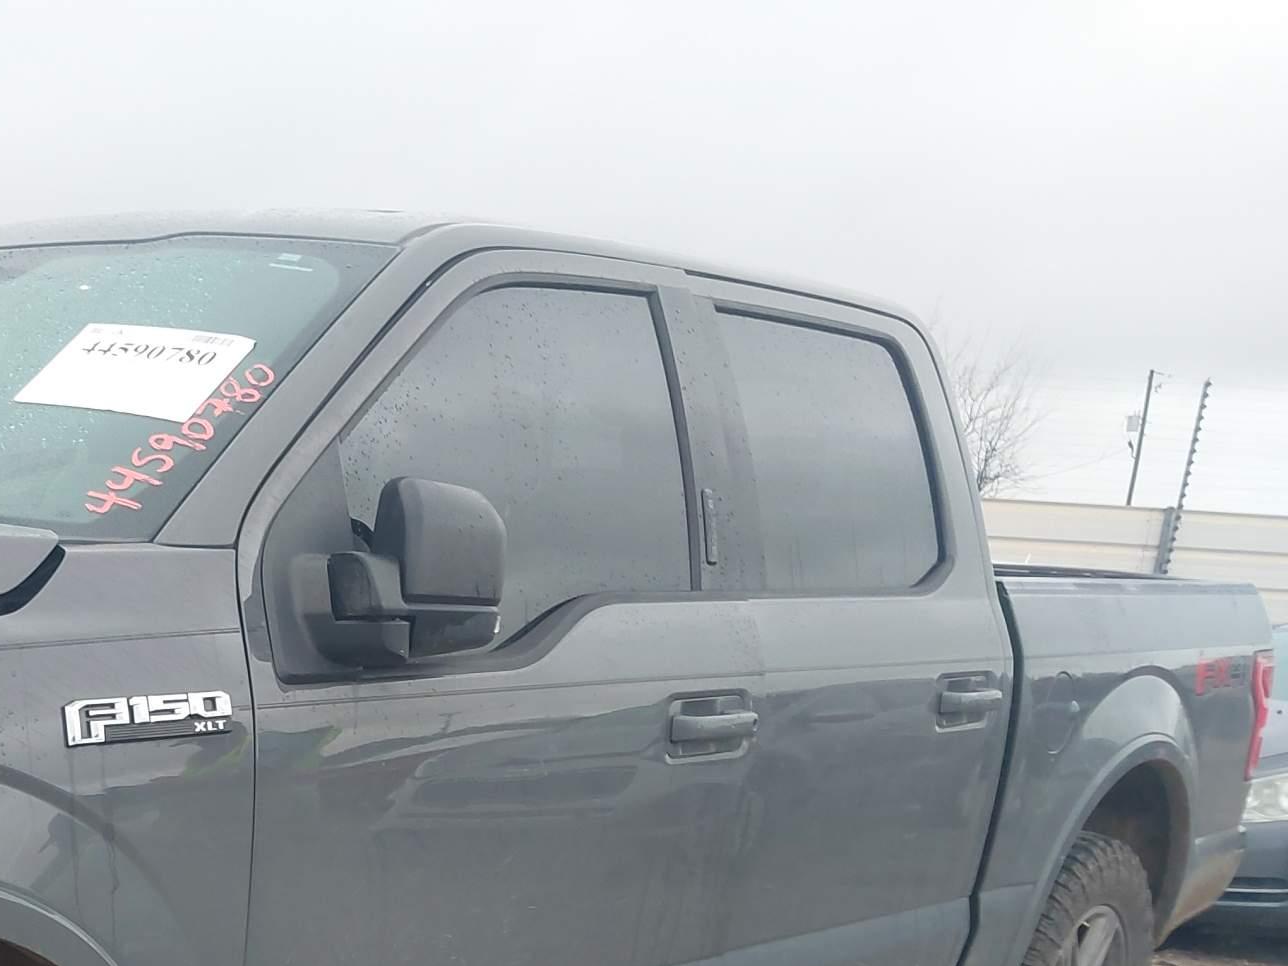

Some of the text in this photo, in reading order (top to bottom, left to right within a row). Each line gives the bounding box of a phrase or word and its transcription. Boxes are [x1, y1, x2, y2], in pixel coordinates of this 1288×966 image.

[82, 341, 217, 366] 44590780
[84, 363, 276, 516] 44590780
[194, 719, 227, 733] XLT
